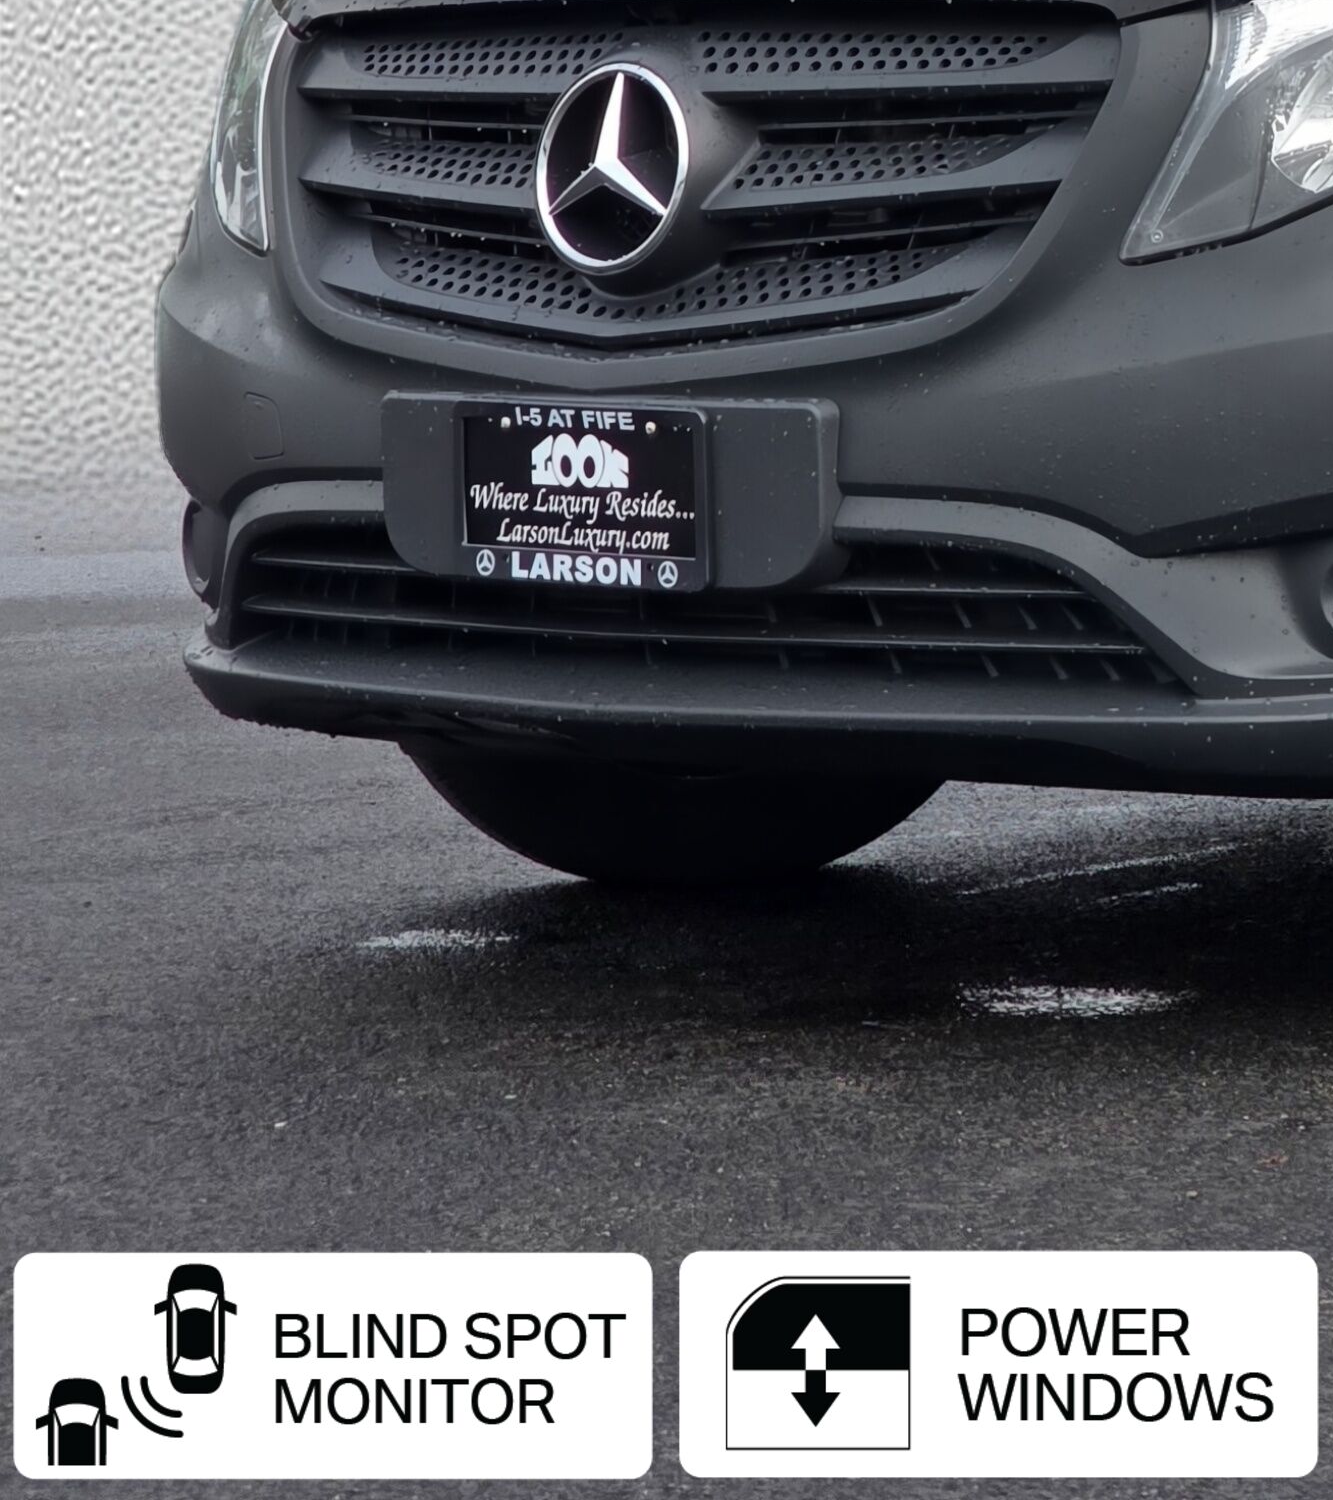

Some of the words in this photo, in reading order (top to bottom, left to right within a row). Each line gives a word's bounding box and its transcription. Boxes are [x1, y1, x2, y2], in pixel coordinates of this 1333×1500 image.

[515, 406, 543, 426] I-5
[547, 409, 576, 428] AT
[582, 410, 635, 431] FIFE
[470, 482, 529, 511] Where
[533, 488, 600, 524] Luxury
[605, 489, 695, 522] Resides...
[496, 518, 670, 555] LarsonLuxury.com
[511, 551, 642, 587] LARSON
